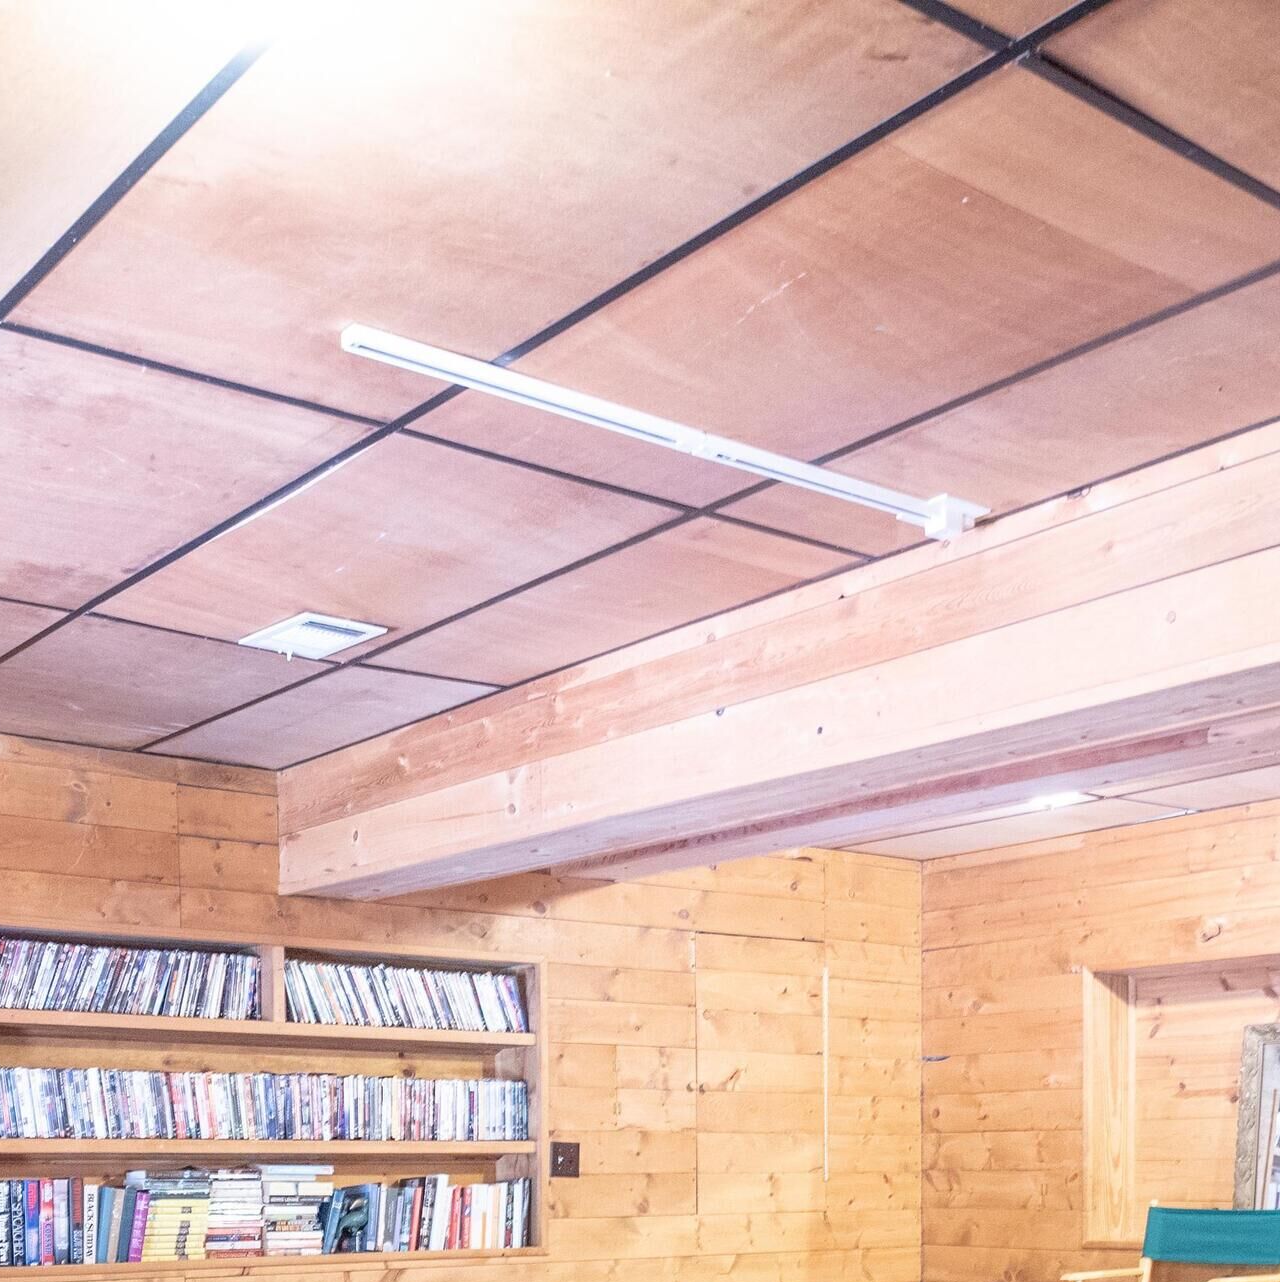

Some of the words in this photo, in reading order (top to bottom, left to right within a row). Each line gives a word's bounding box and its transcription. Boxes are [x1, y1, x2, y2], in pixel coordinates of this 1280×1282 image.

[86, 1193, 95, 1222] BLACK
[12, 1202, 24, 1257] SPYCATCHER
[84, 1223, 95, 1257] SUNDAY
